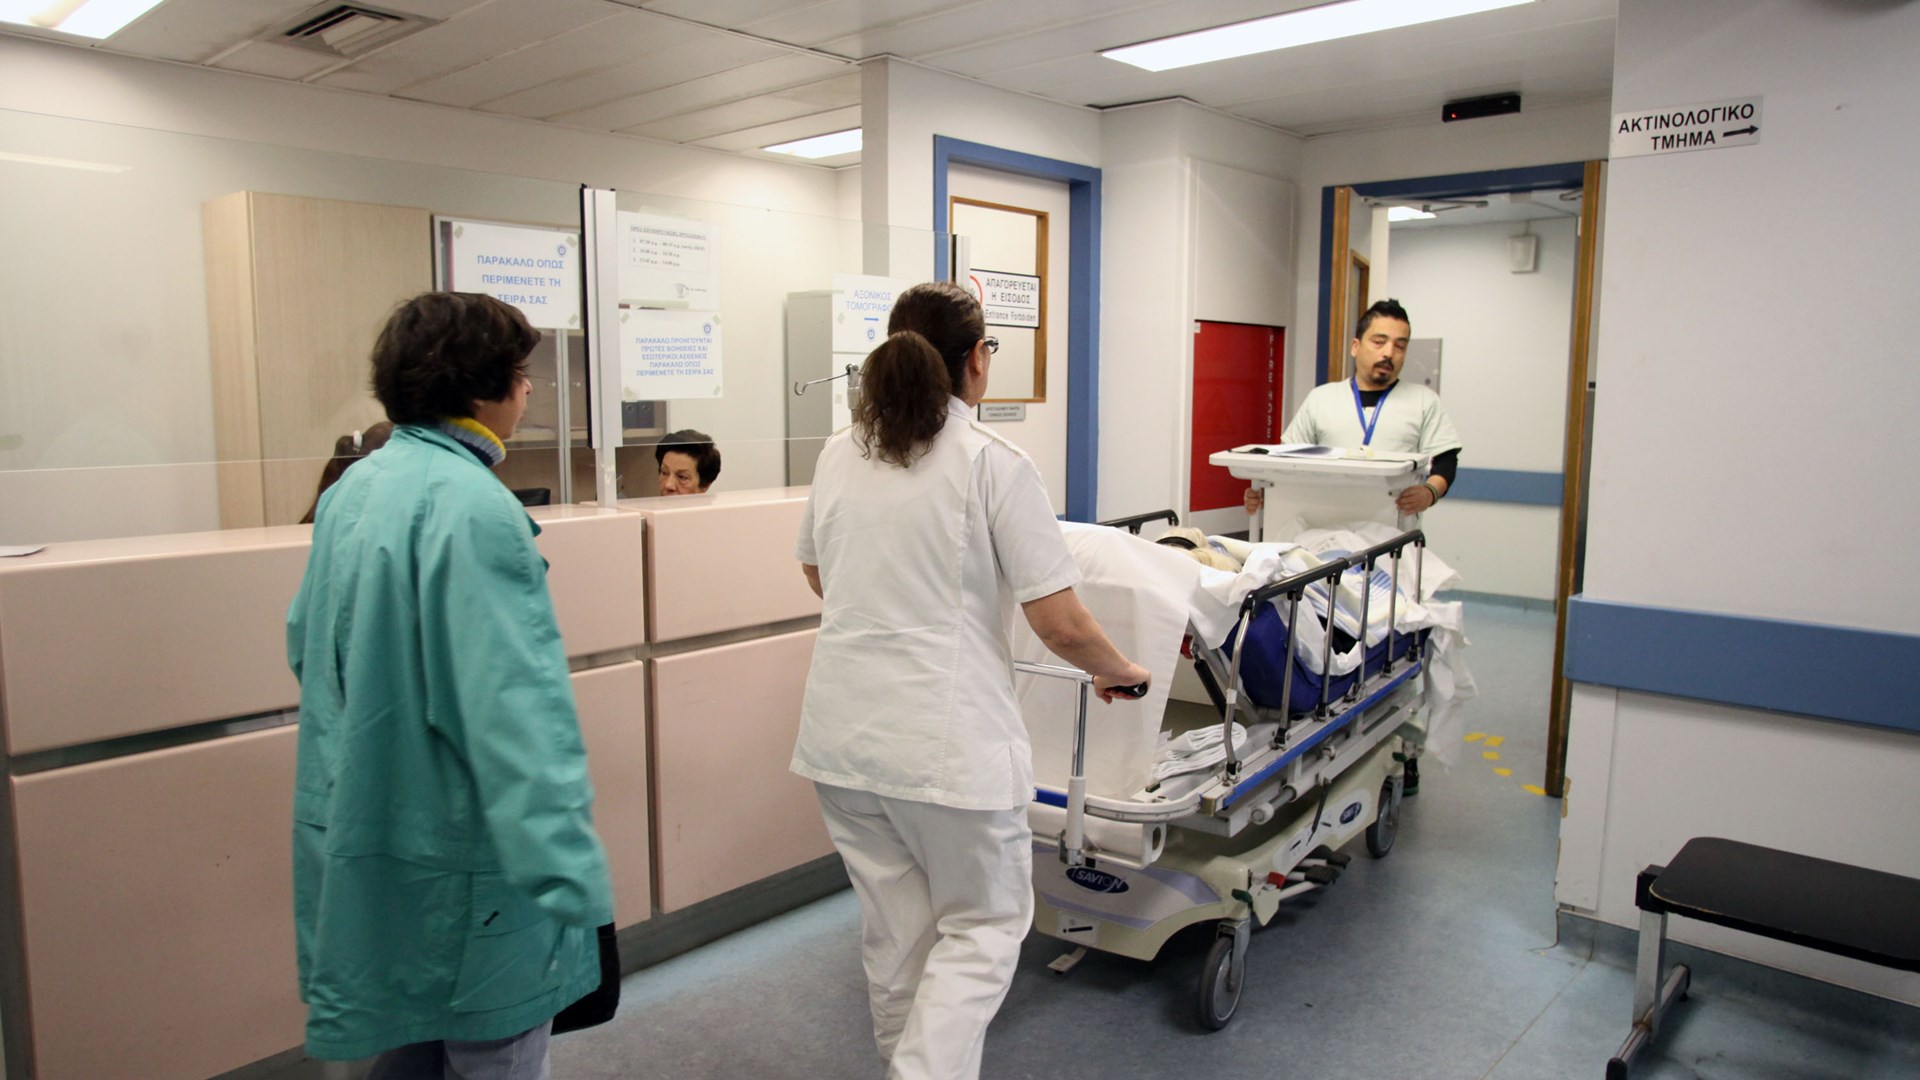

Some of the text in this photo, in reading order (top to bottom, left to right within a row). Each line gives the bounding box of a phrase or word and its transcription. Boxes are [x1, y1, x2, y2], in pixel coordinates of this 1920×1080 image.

[1618, 103, 1755, 134] ΑΚΤΙΝΟΛΟΓΙΚΟ
[1651, 130, 1716, 150] ΤΜΗΜΑ
[477, 255, 565, 269] ΠΑΡΑΚΑΛΩ ΟΠΩΣ
[482, 274, 561, 287] ΠΕΡΙΜΕΝΕΤΕ ΤΗ
[986, 278, 1037, 291] ΑΠΑΓΟΡΕΥΕΤΑΙ
[529, 295, 548, 305] ΣΑΣ
[853, 290, 892, 301] ΑΞΟΝΙΚΟΣ
[991, 291, 1031, 304] Η ΕΙΣΟΔΟΣ
[846, 301, 893, 312] ΤΟΜΟΓΡΑΦΟ
[985, 308, 1009, 320] Entrance
[1076, 869, 1124, 890] SAVION
